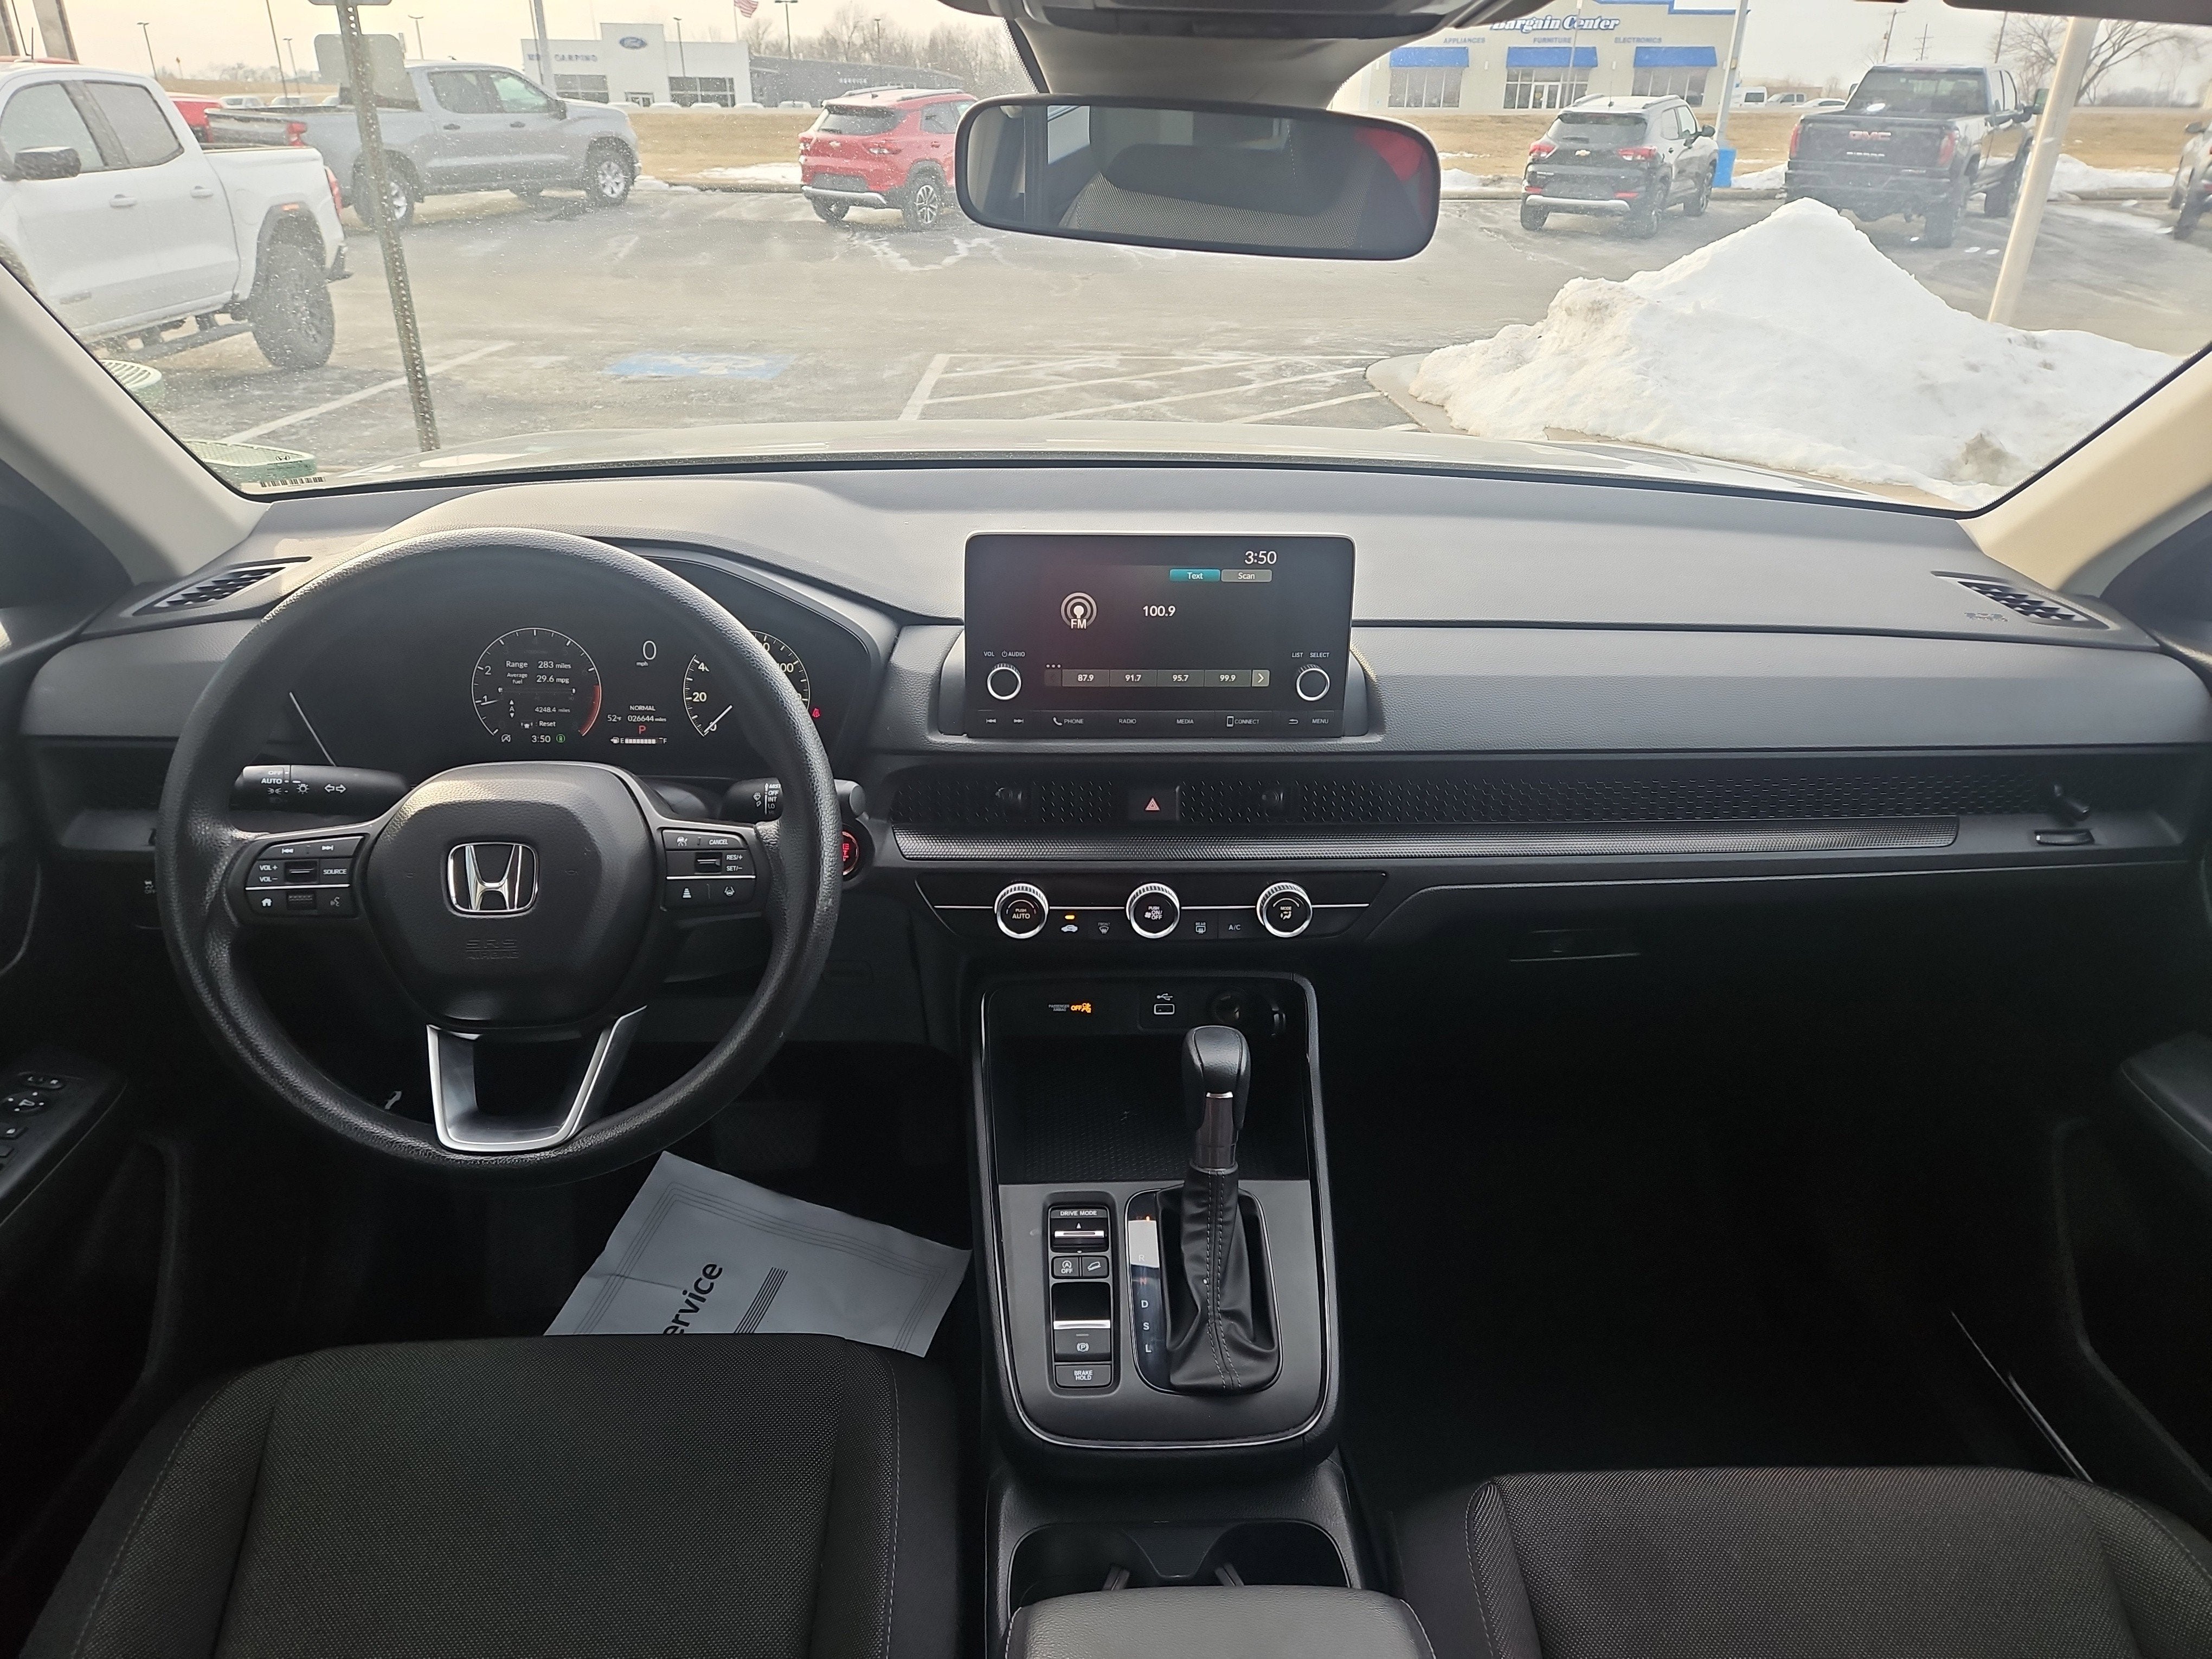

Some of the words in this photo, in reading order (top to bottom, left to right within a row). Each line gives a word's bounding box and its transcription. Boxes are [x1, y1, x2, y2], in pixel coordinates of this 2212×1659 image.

[1562, 15, 1620, 30] Center
[1849, 130, 1891, 141] GMC
[1244, 550, 1277, 565] 3:50
[1186, 572, 1204, 580] Text
[1238, 572, 1255, 580] Scan
[1142, 606, 1176, 617] 100.9
[1070, 619, 1087, 629] FM
[642, 640, 657, 660] 0
[506, 660, 528, 669] Range
[485, 665, 492, 675] 2
[692, 692, 707, 702] 20
[638, 725, 646, 735] P
[531, 735, 551, 743] 3:50
[1141, 1300, 1148, 1308] D
[1143, 1322, 1150, 1331] S
[1145, 1344, 1152, 1353] L
